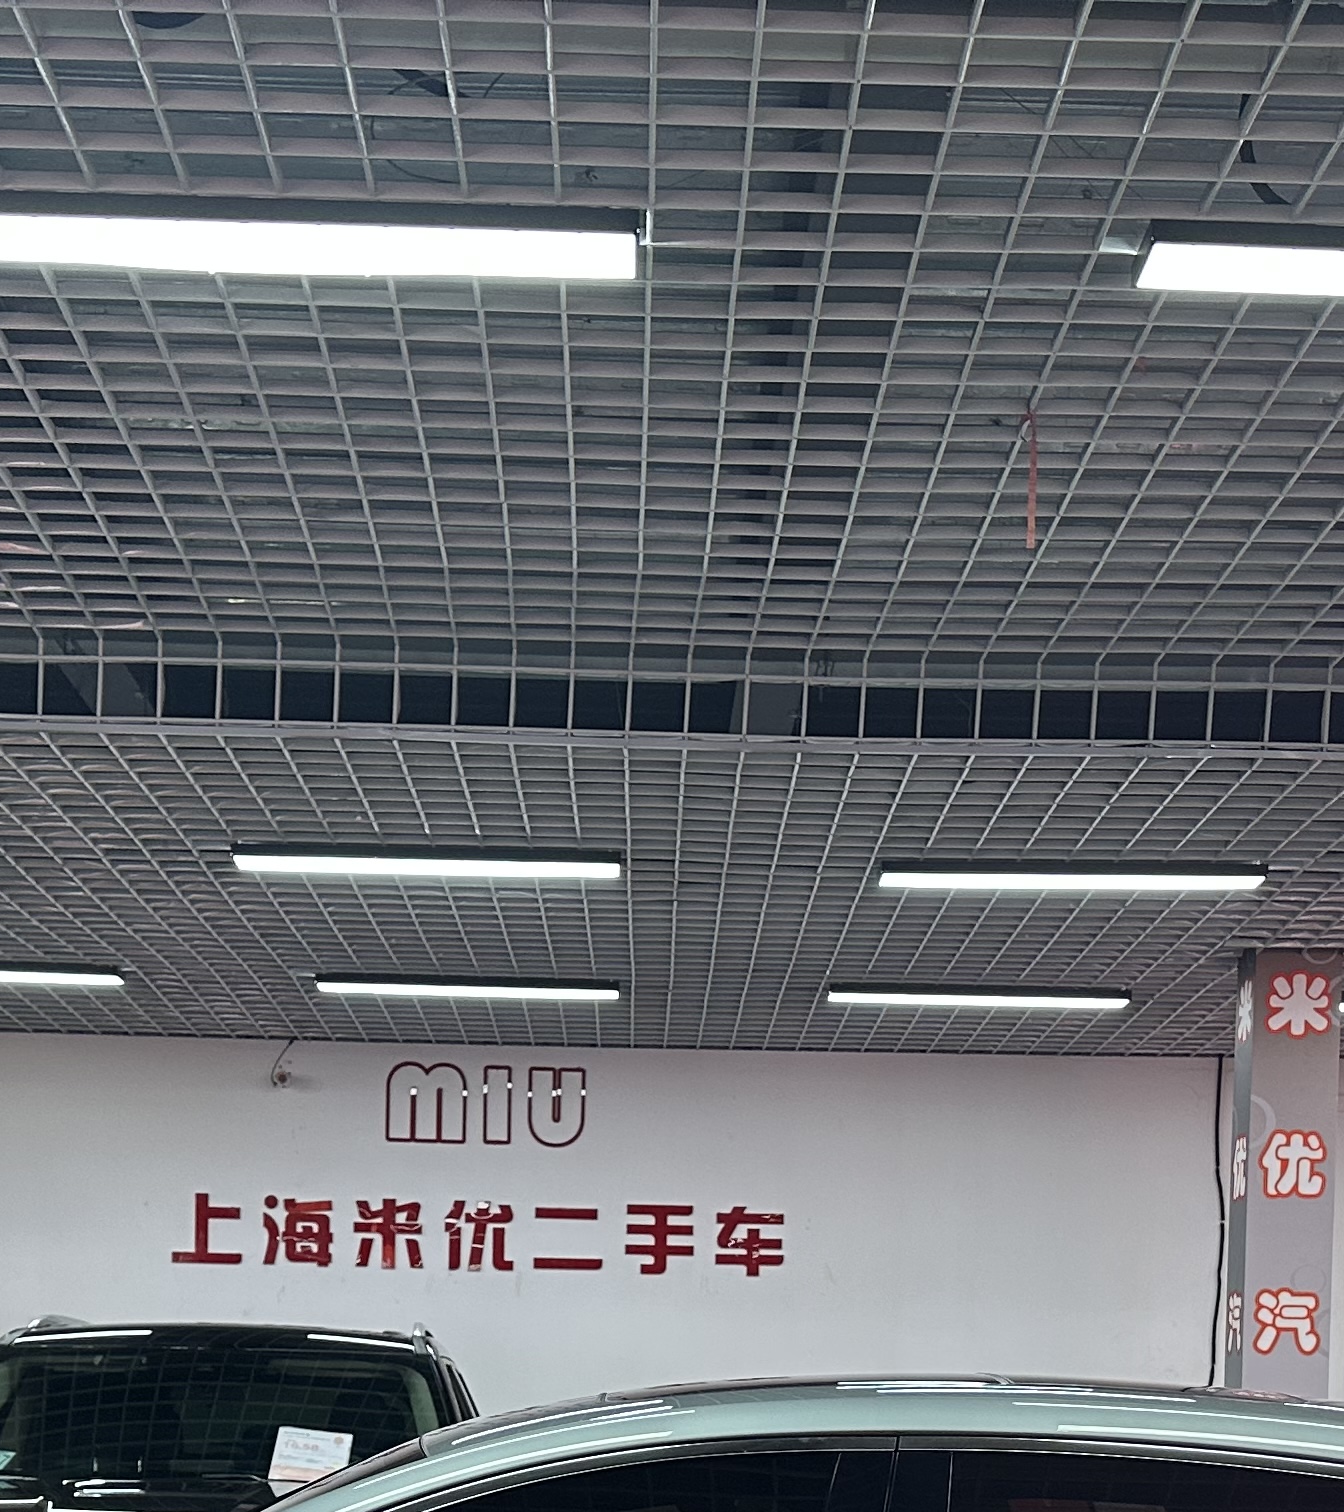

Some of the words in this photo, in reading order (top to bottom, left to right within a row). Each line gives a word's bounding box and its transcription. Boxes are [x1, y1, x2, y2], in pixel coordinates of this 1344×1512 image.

[172, 1193, 785, 1276] 上海米优二手车
[1253, 970, 1332, 1356] 米优汽
